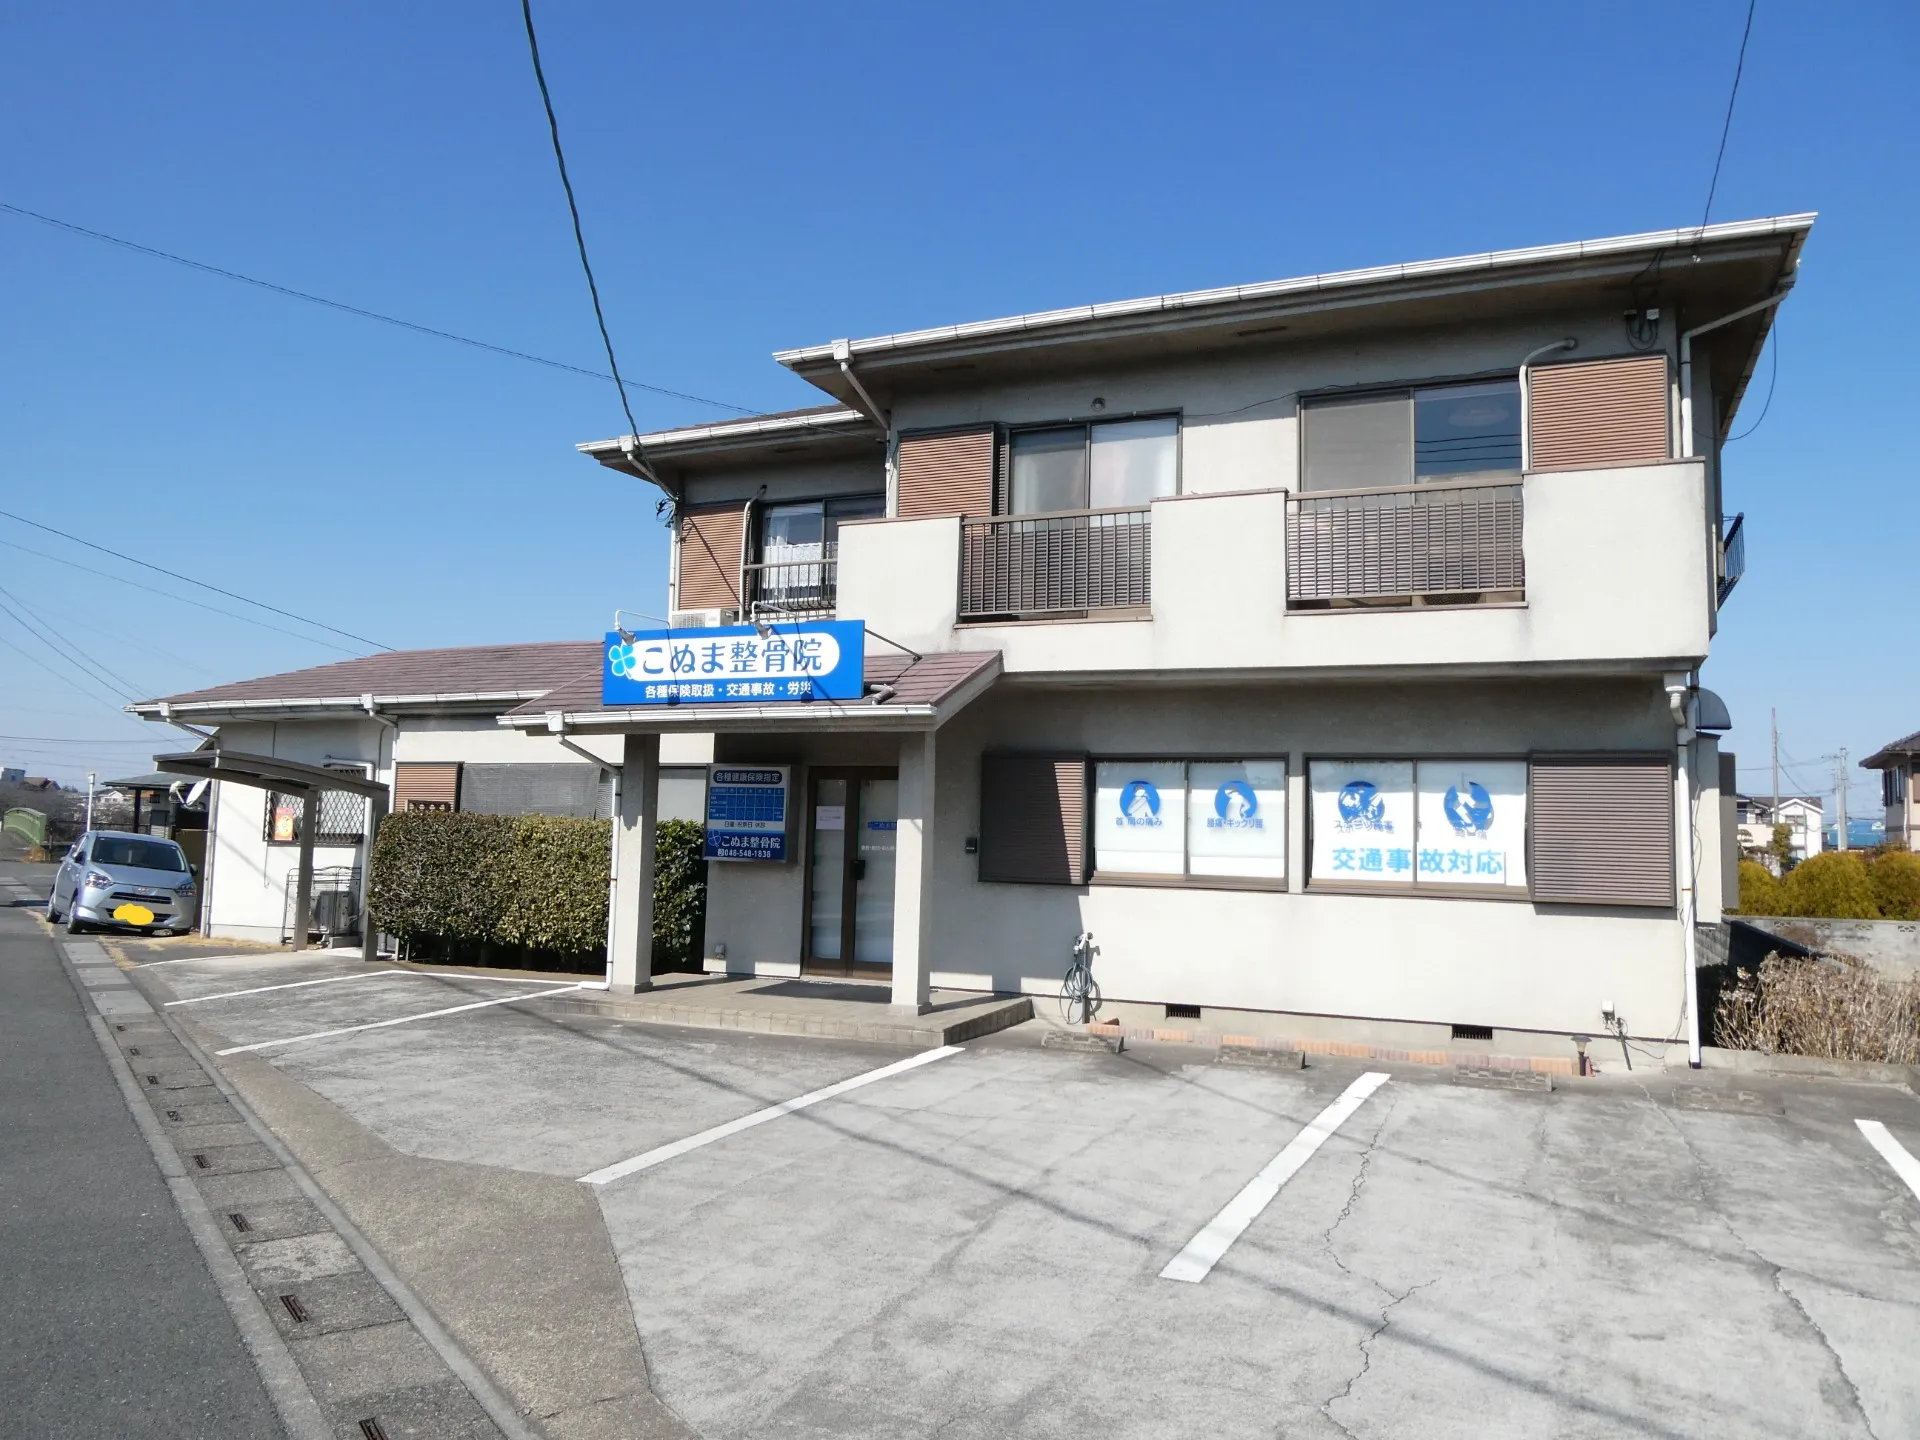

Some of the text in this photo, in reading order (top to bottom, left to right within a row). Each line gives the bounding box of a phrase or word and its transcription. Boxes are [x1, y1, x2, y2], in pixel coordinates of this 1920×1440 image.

[642, 637, 823, 675] こぬま整骨院
[645, 681, 812, 699] 各種保険取扱・交通事故・労災
[721, 836, 781, 849] こぬま整骨院
[1332, 847, 1504, 875] 交通事故対応
